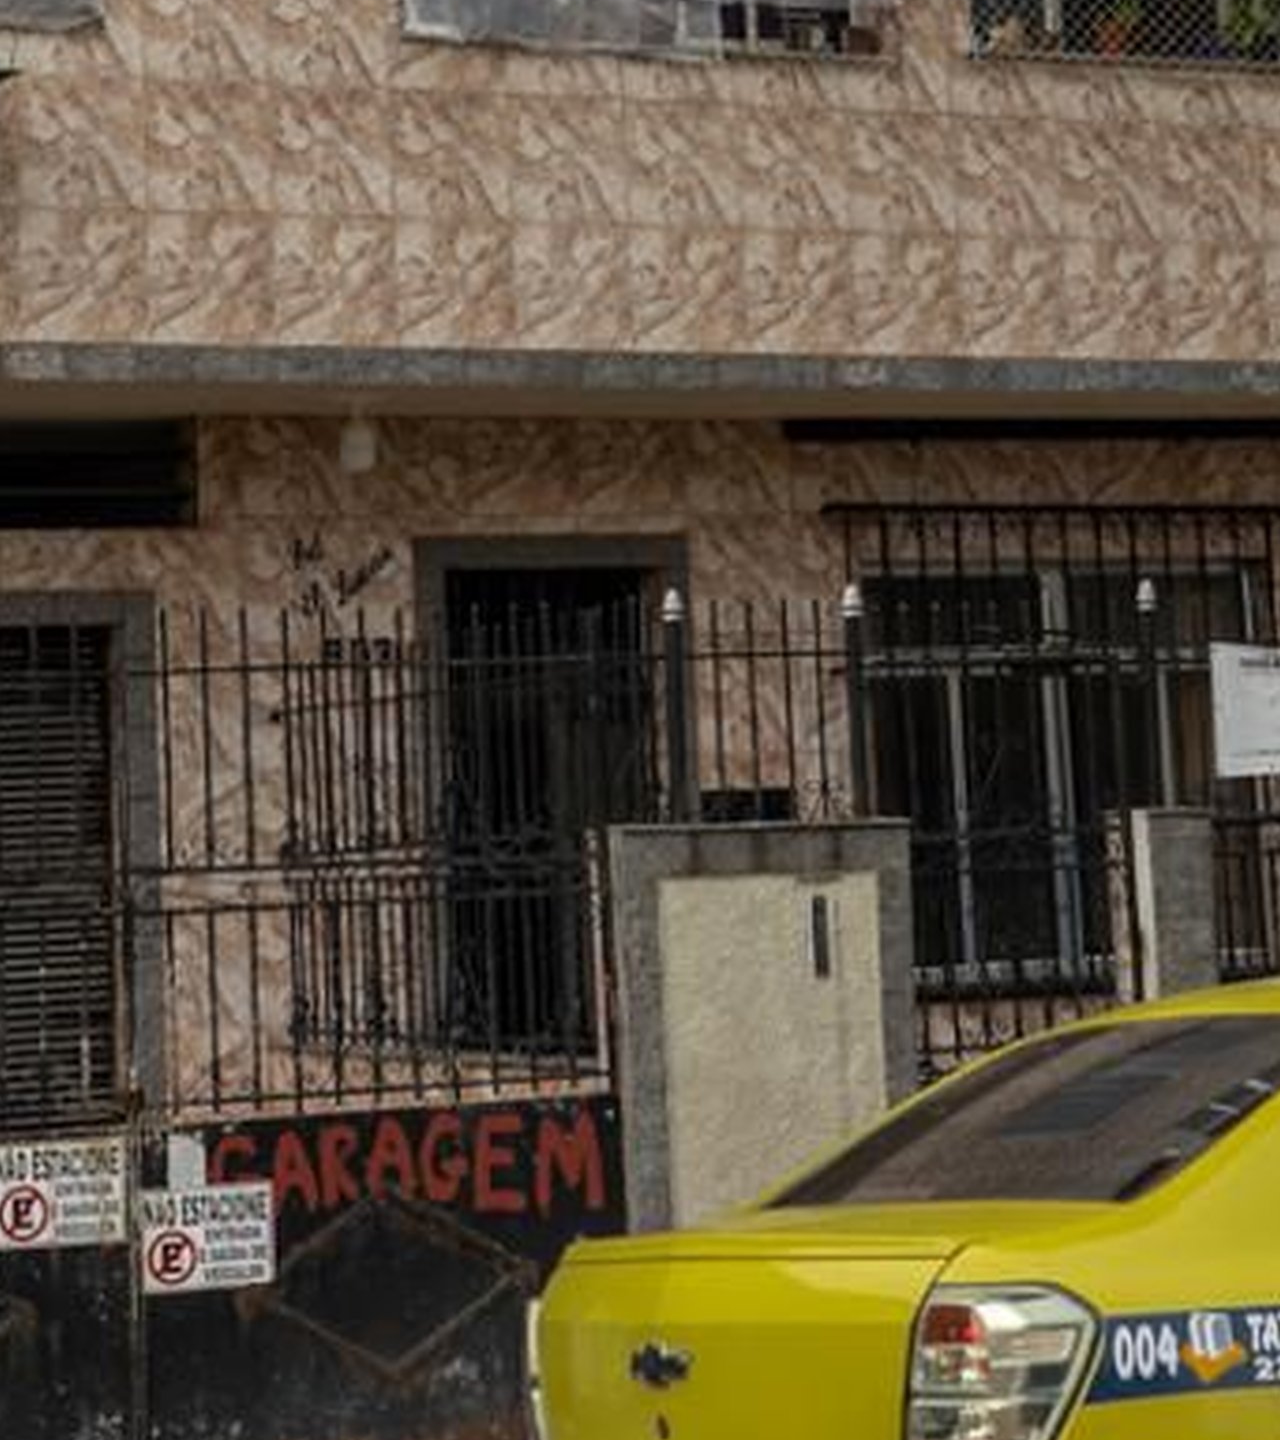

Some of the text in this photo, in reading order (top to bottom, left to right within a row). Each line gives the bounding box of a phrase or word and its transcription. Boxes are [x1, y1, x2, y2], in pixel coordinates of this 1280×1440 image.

[32, 1144, 119, 1181] ESTACIONE
[181, 1191, 267, 1226] ESTACIONE
[1113, 1323, 1178, 1382] 004
